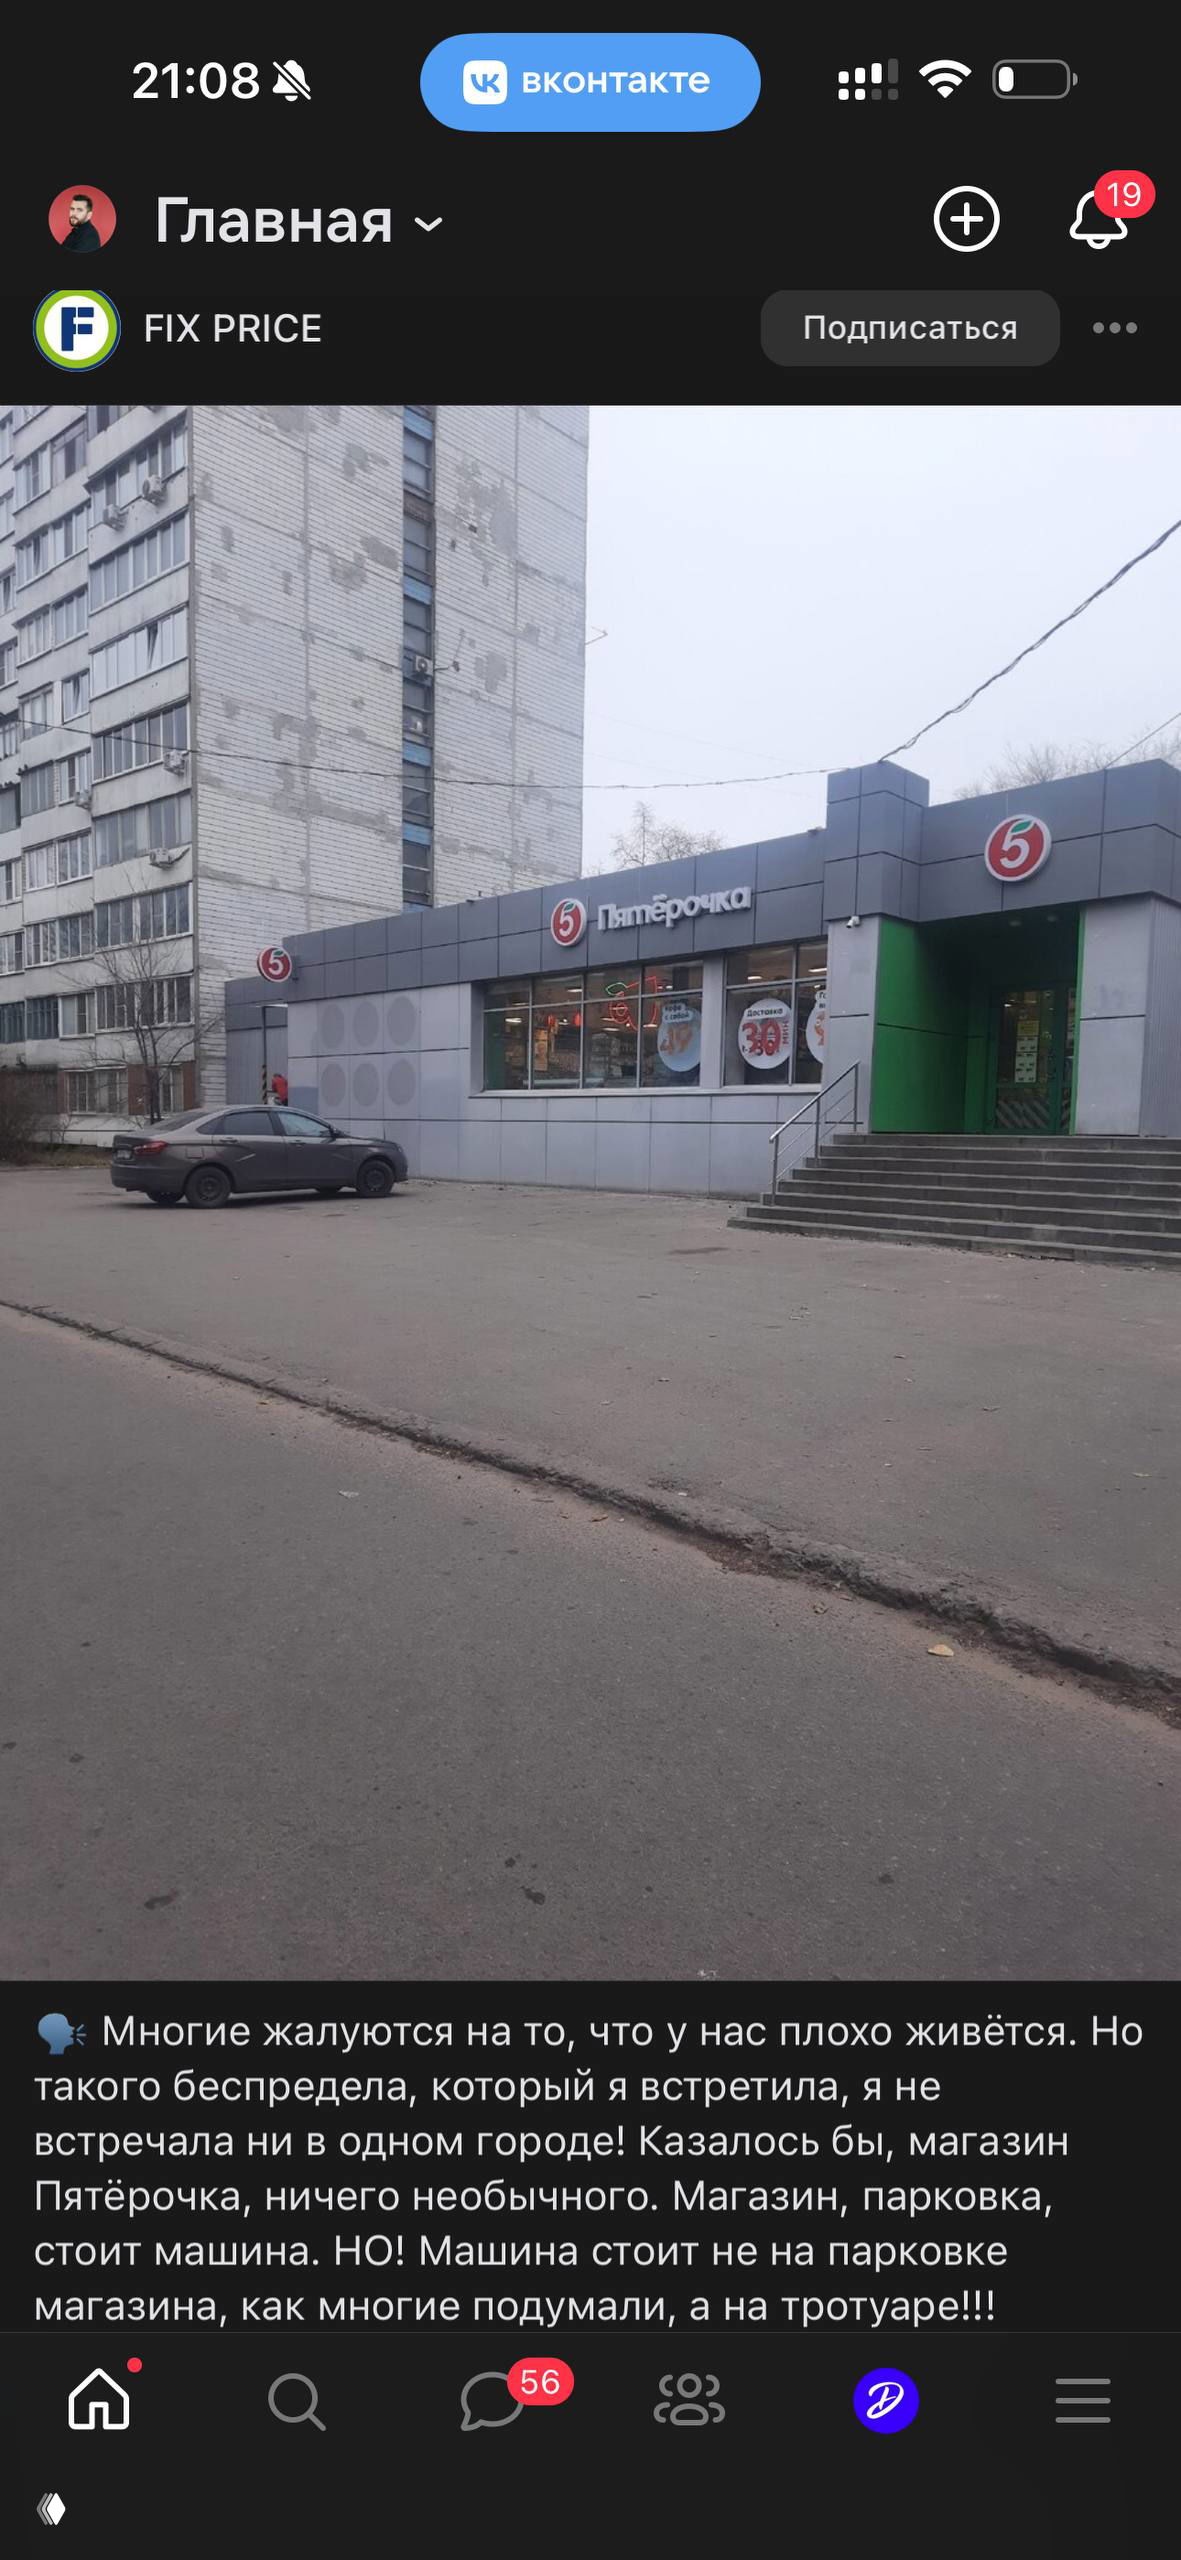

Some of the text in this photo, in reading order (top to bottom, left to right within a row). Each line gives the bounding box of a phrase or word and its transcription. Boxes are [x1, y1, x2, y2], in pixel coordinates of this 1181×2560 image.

[1000, 820, 1034, 868] 5
[597, 886, 752, 931] Пятёрочка
[747, 1008, 783, 1017] Доставка
[742, 1019, 781, 1056] 30
